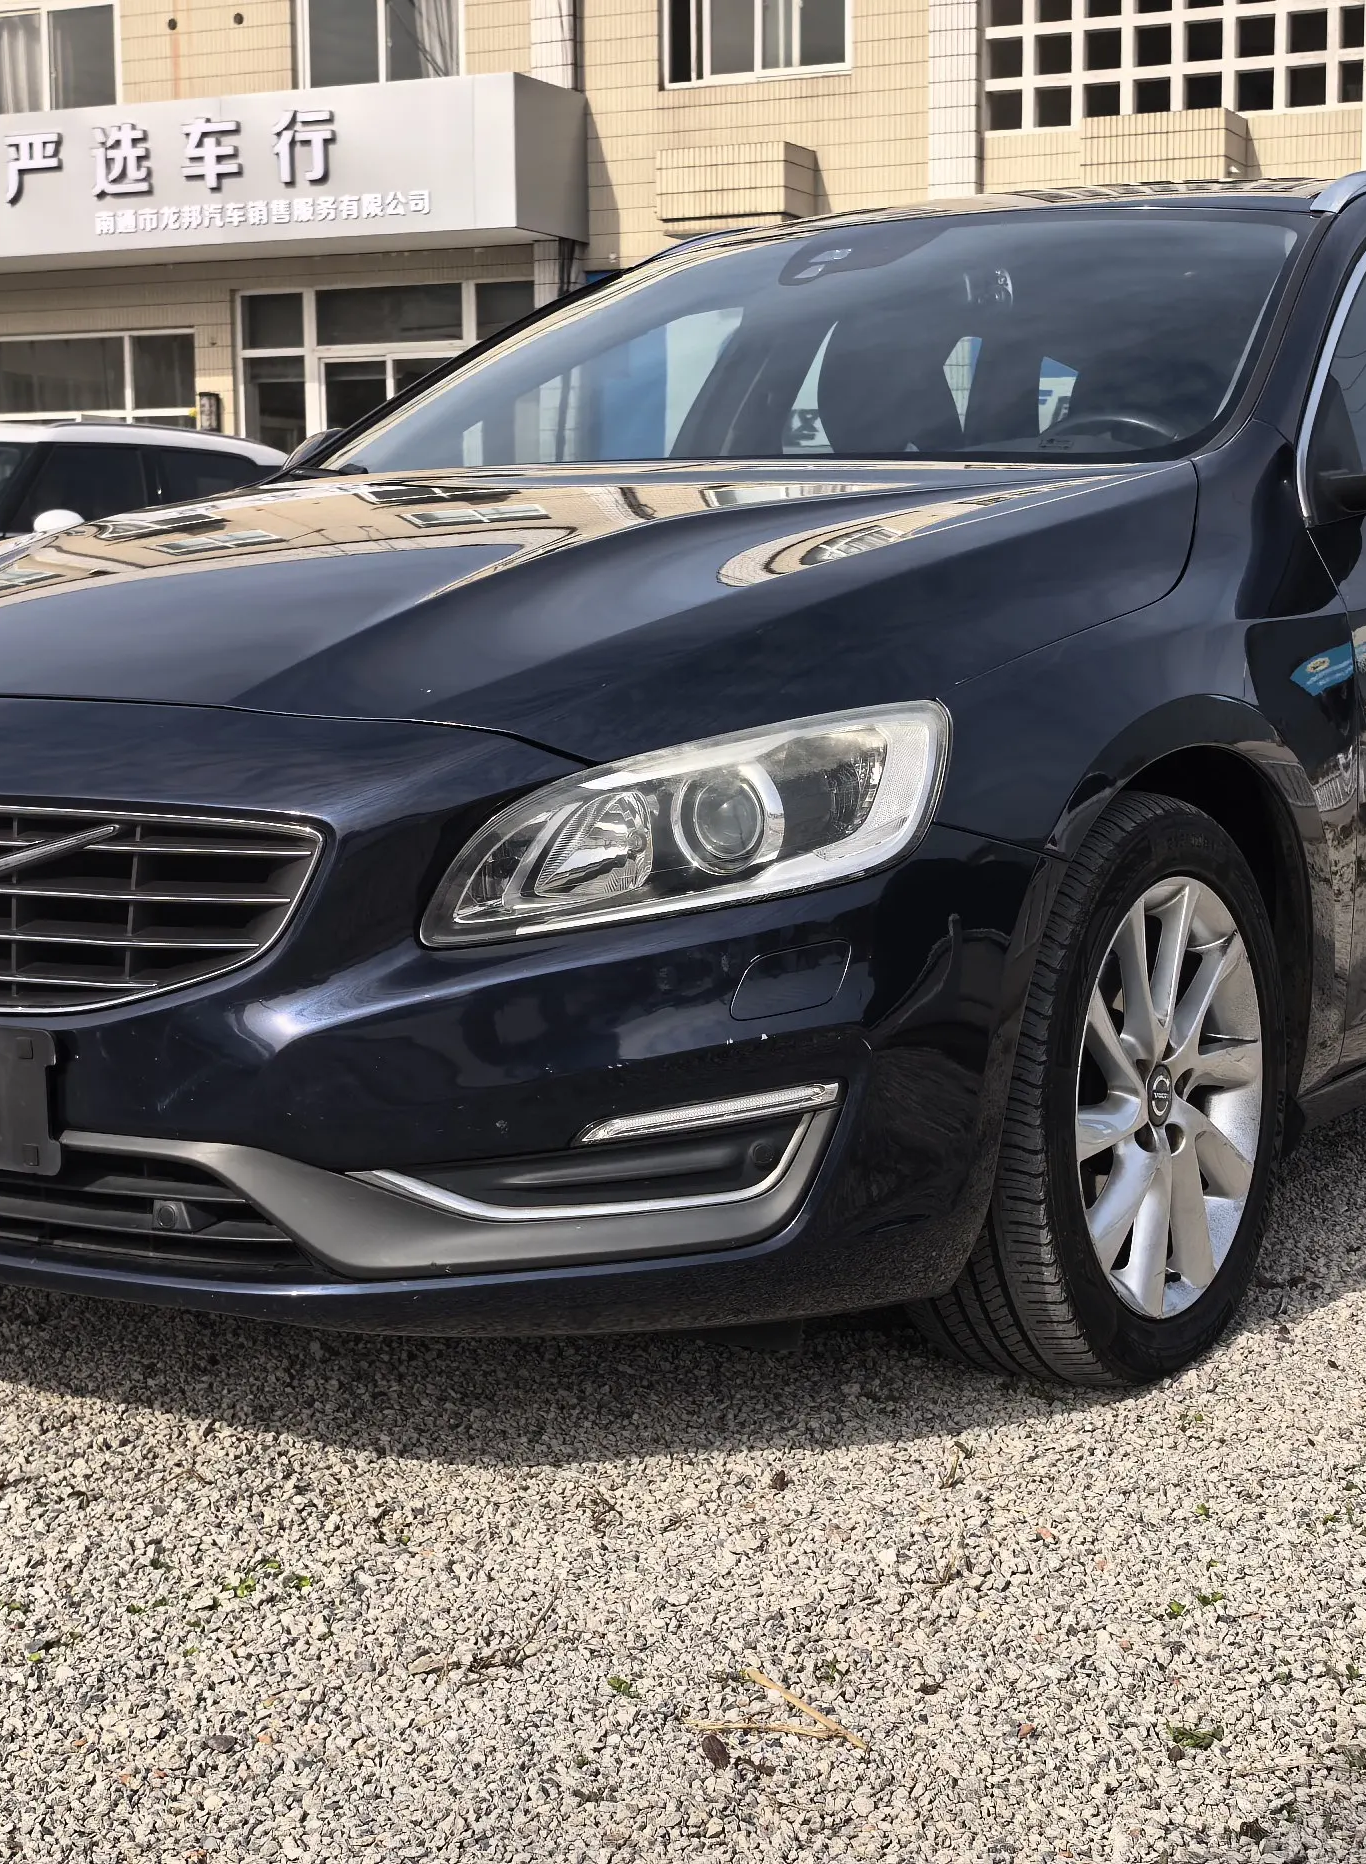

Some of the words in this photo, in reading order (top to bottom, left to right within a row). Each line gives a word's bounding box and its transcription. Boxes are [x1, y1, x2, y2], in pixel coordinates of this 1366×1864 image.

[94, 189, 431, 235] 南通市龙邦汽车销售服务有限公司
